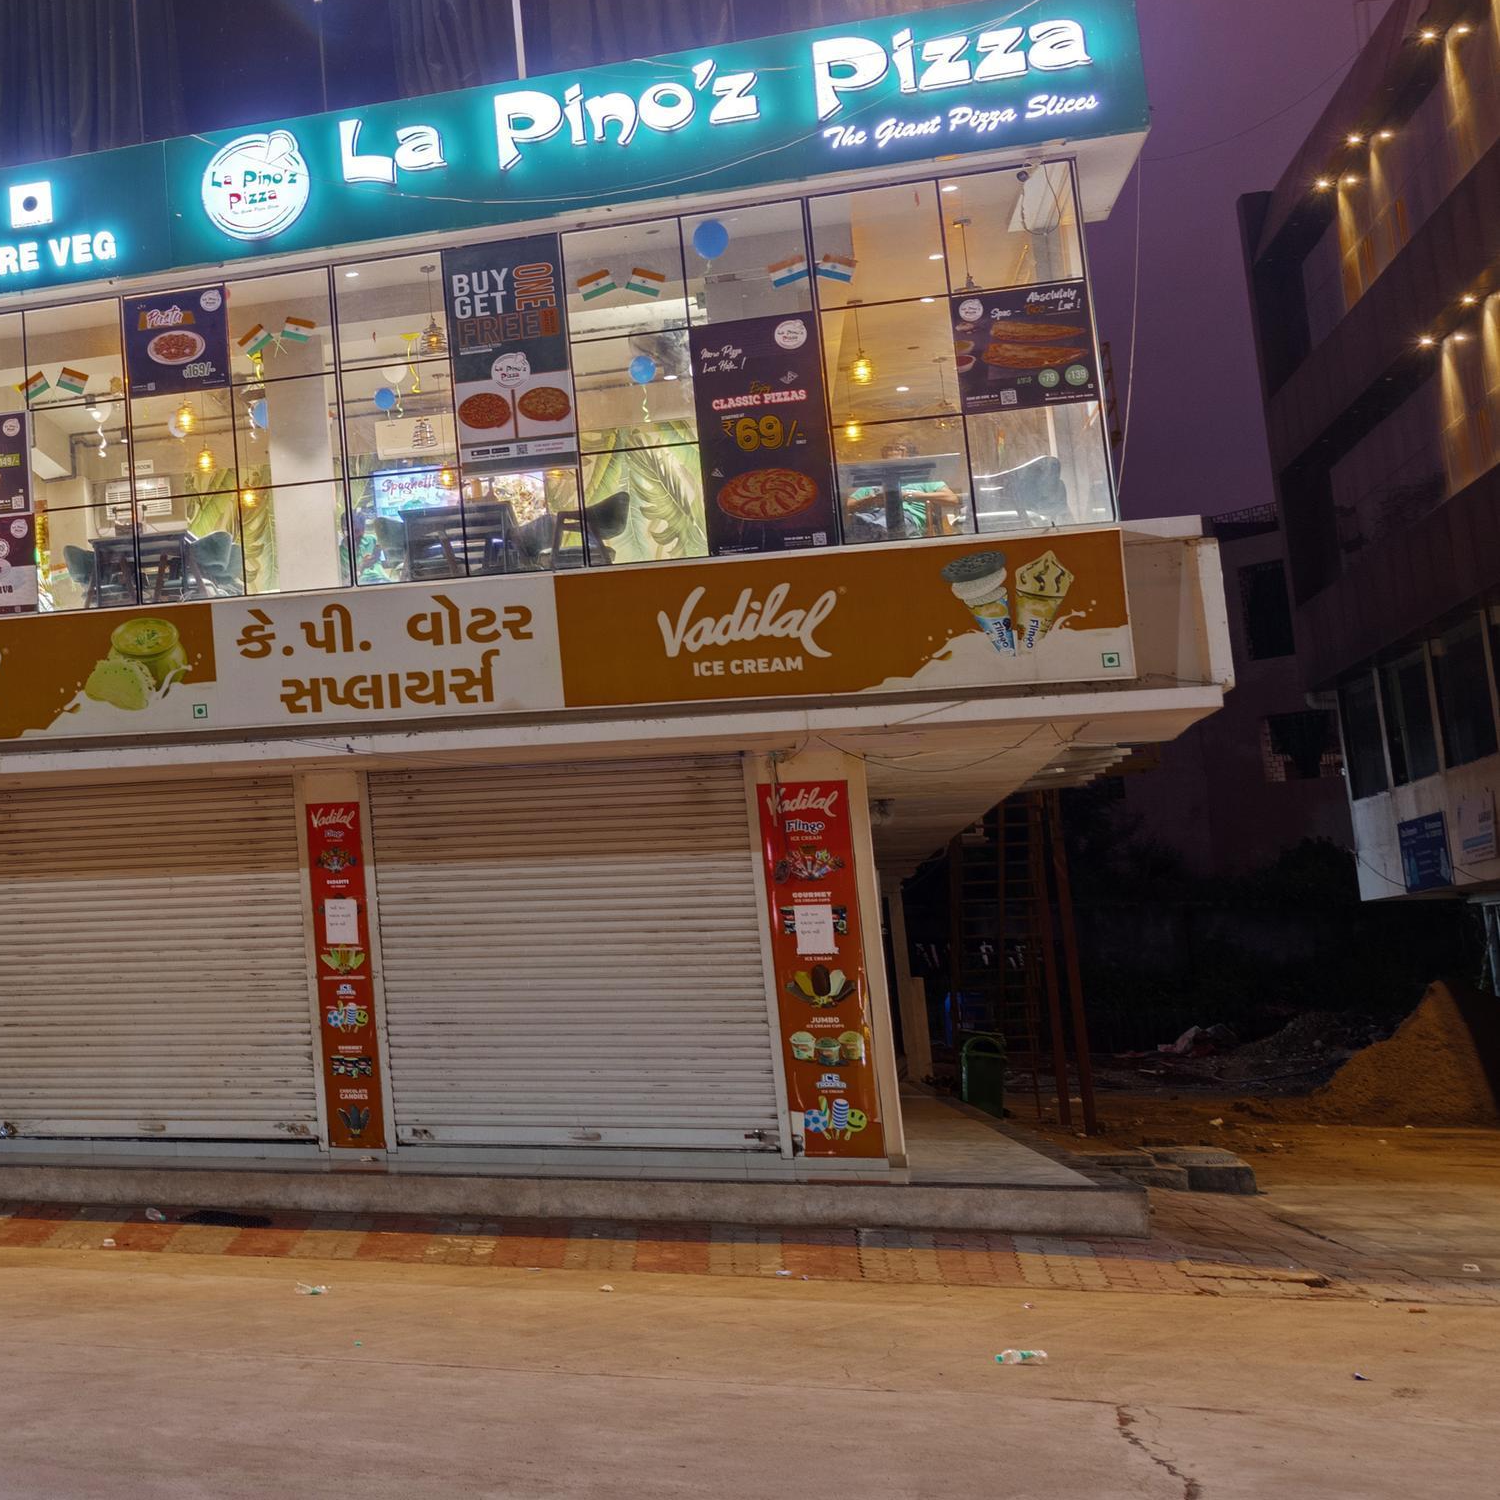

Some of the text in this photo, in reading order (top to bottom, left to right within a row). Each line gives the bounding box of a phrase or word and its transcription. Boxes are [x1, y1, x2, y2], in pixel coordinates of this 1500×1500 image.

[338, 15, 1093, 186] La Pino'z Pizza
[823, 91, 1101, 151] The Giant Pizza Slices
[211, 171, 232, 188] La
[229, 189, 277, 210] Pizza
[48, 230, 118, 265] VEG
[452, 268, 508, 297] BUY
[513, 262, 556, 311] ONE
[147, 305, 184, 328] Pasta
[455, 291, 506, 319] GET
[458, 311, 540, 347] FREE
[712, 389, 807, 411] CLASSIC PIZZAS
[657, 582, 837, 659] Vadilal
[693, 655, 804, 677] ICE CREAM
[311, 808, 355, 829] Vadilal
[785, 819, 825, 834] Flingo
[811, 1016, 839, 1024] JUMBO
[822, 1073, 840, 1083] ICE
